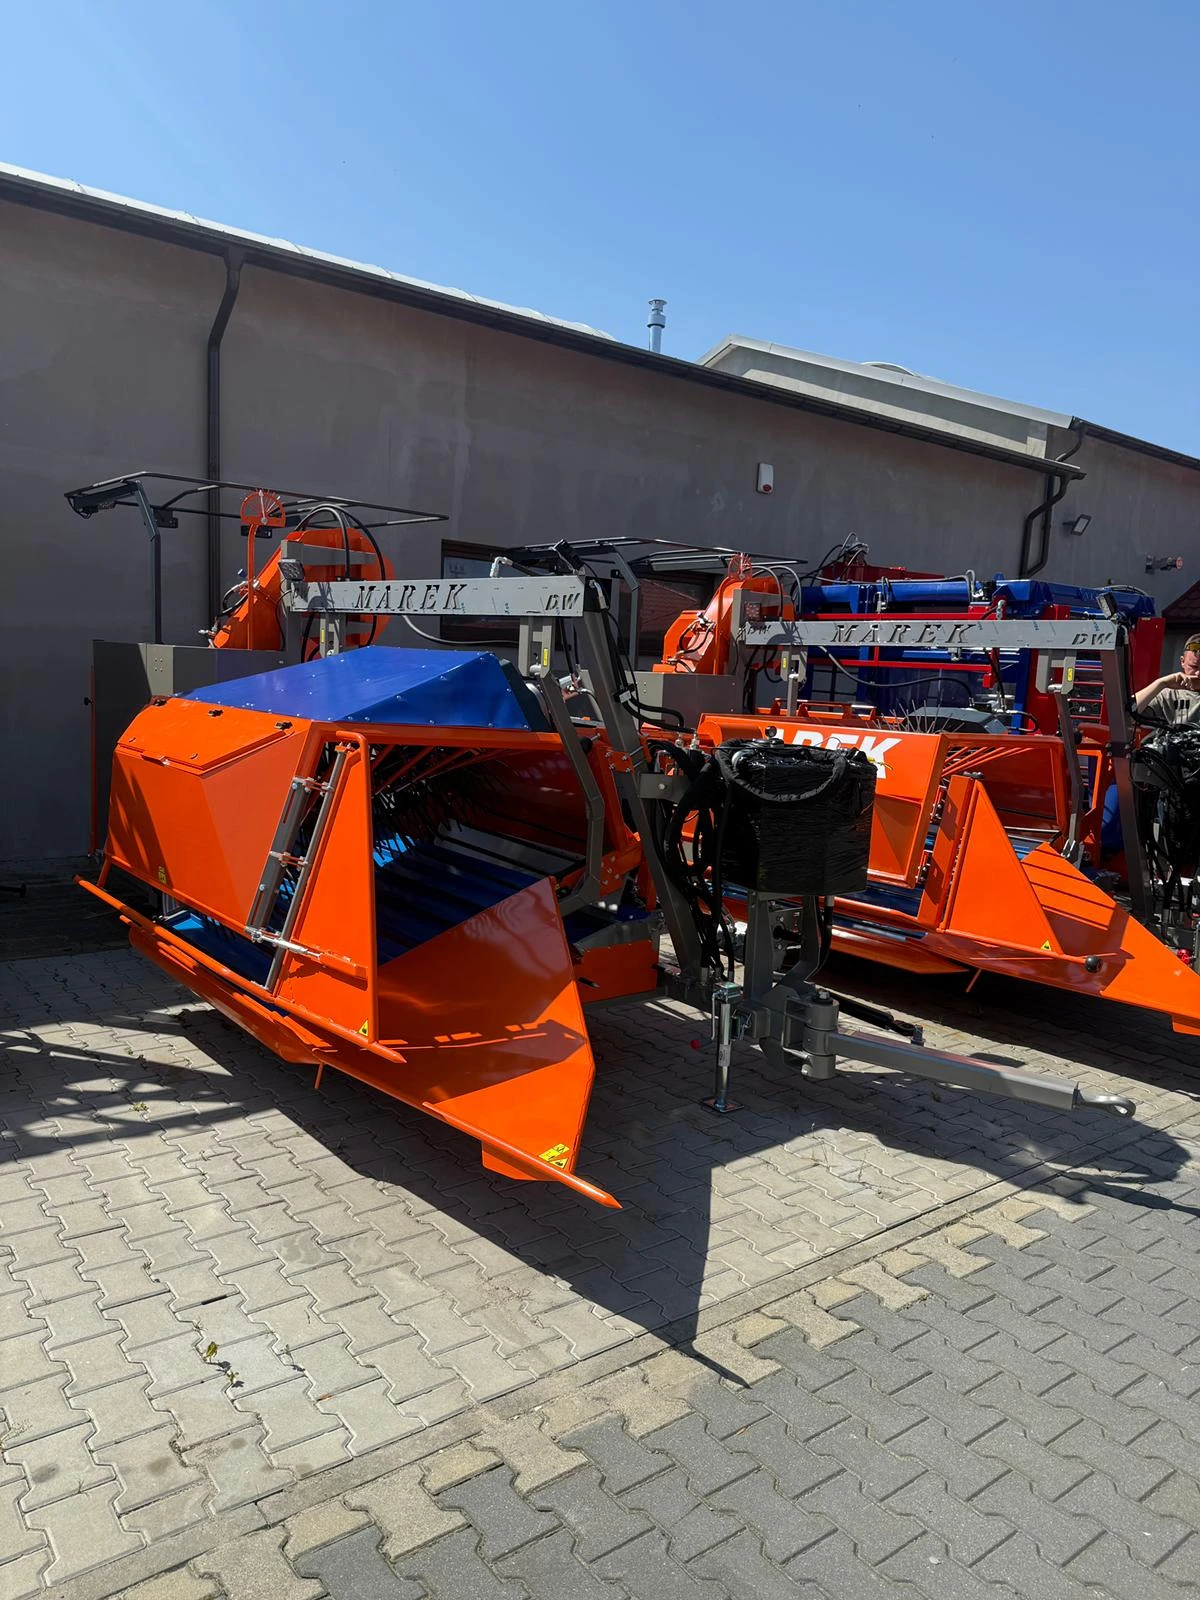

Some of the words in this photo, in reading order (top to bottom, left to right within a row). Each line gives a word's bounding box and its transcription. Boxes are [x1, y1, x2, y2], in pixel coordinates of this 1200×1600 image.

[354, 583, 467, 610] MAREK
[545, 592, 580, 611] DW
[830, 623, 976, 644] MAREK
[1071, 632, 1113, 646] DW
